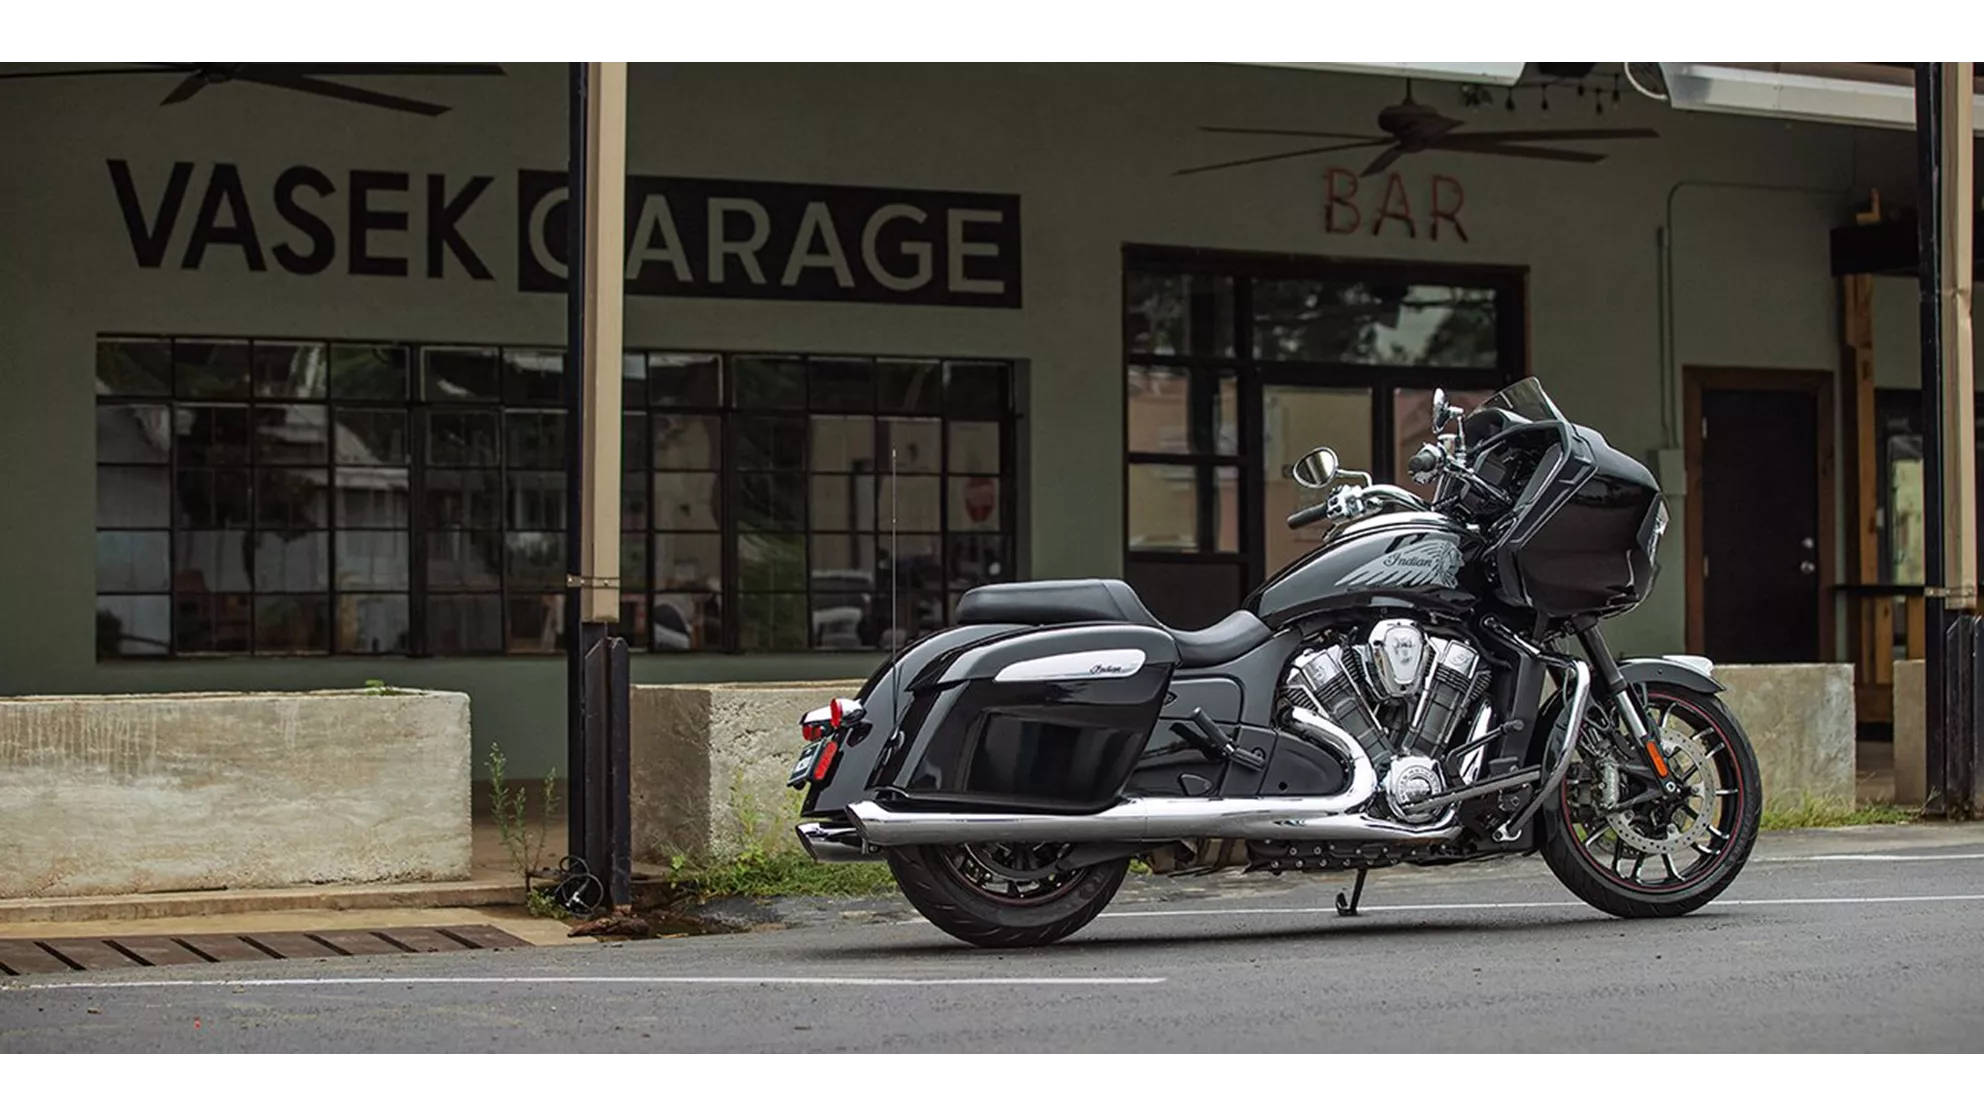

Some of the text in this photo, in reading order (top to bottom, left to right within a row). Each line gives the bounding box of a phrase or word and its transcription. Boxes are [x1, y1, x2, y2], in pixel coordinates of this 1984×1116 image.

[106, 158, 495, 281] VASEK
[1324, 168, 1468, 242] BAR
[1384, 552, 1432, 567] Indian
